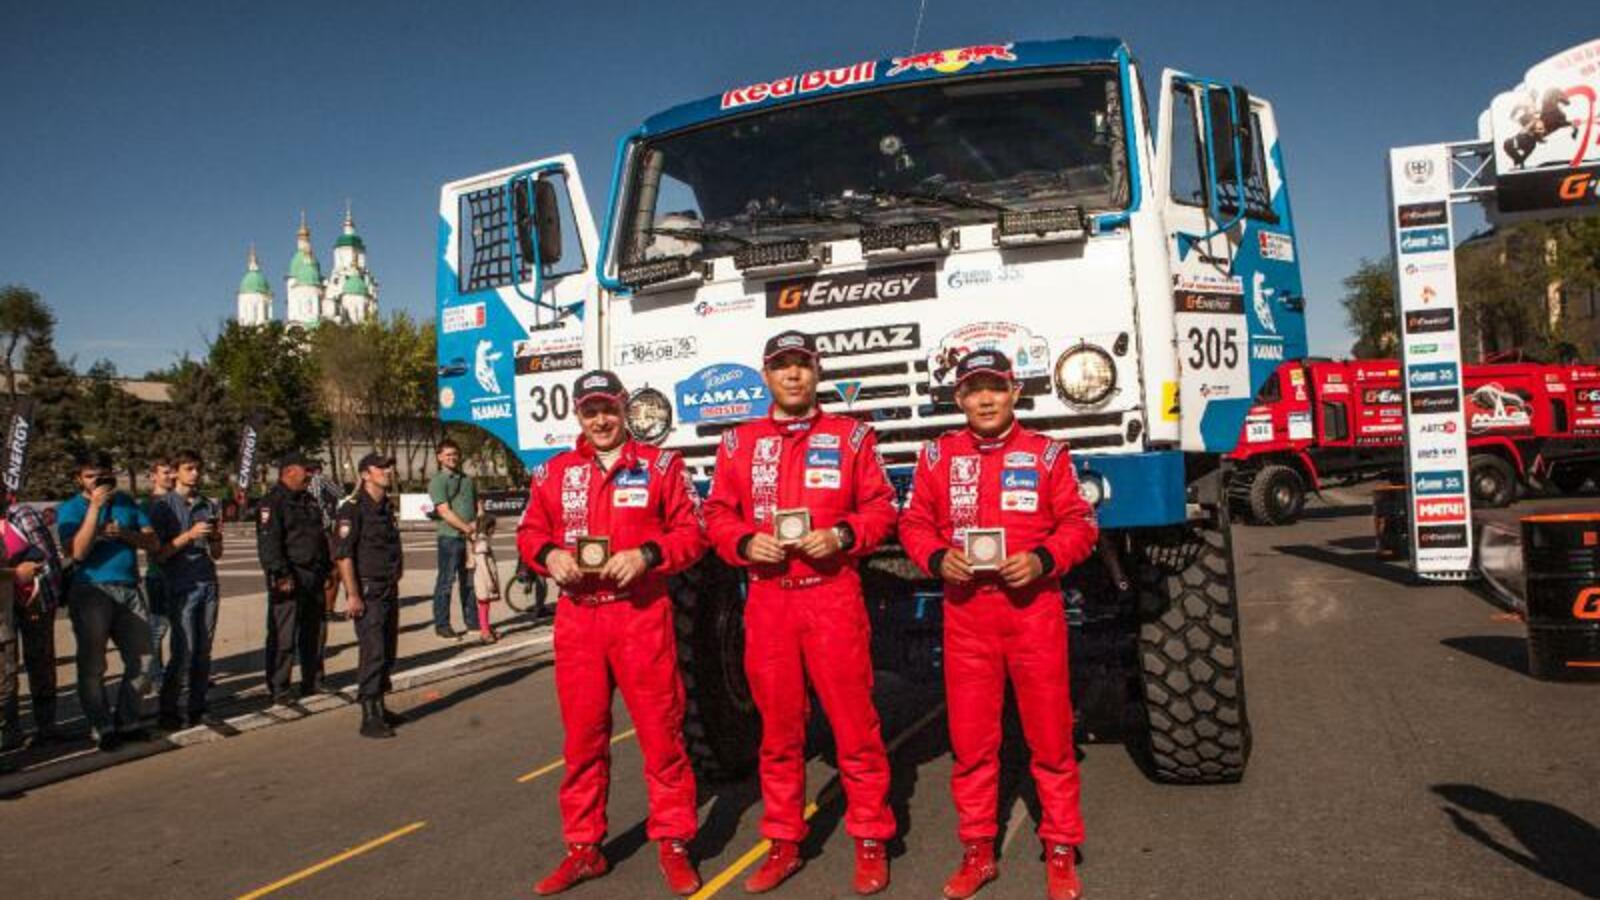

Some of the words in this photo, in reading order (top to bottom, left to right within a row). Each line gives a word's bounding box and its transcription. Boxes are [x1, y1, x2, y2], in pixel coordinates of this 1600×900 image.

[720, 75, 797, 111] Red
[798, 61, 877, 94] Bull
[814, 325, 914, 354] AMAZ
[1187, 327, 1239, 370] 305
[529, 384, 574, 423] 30
[683, 386, 765, 407] KAMAZ
